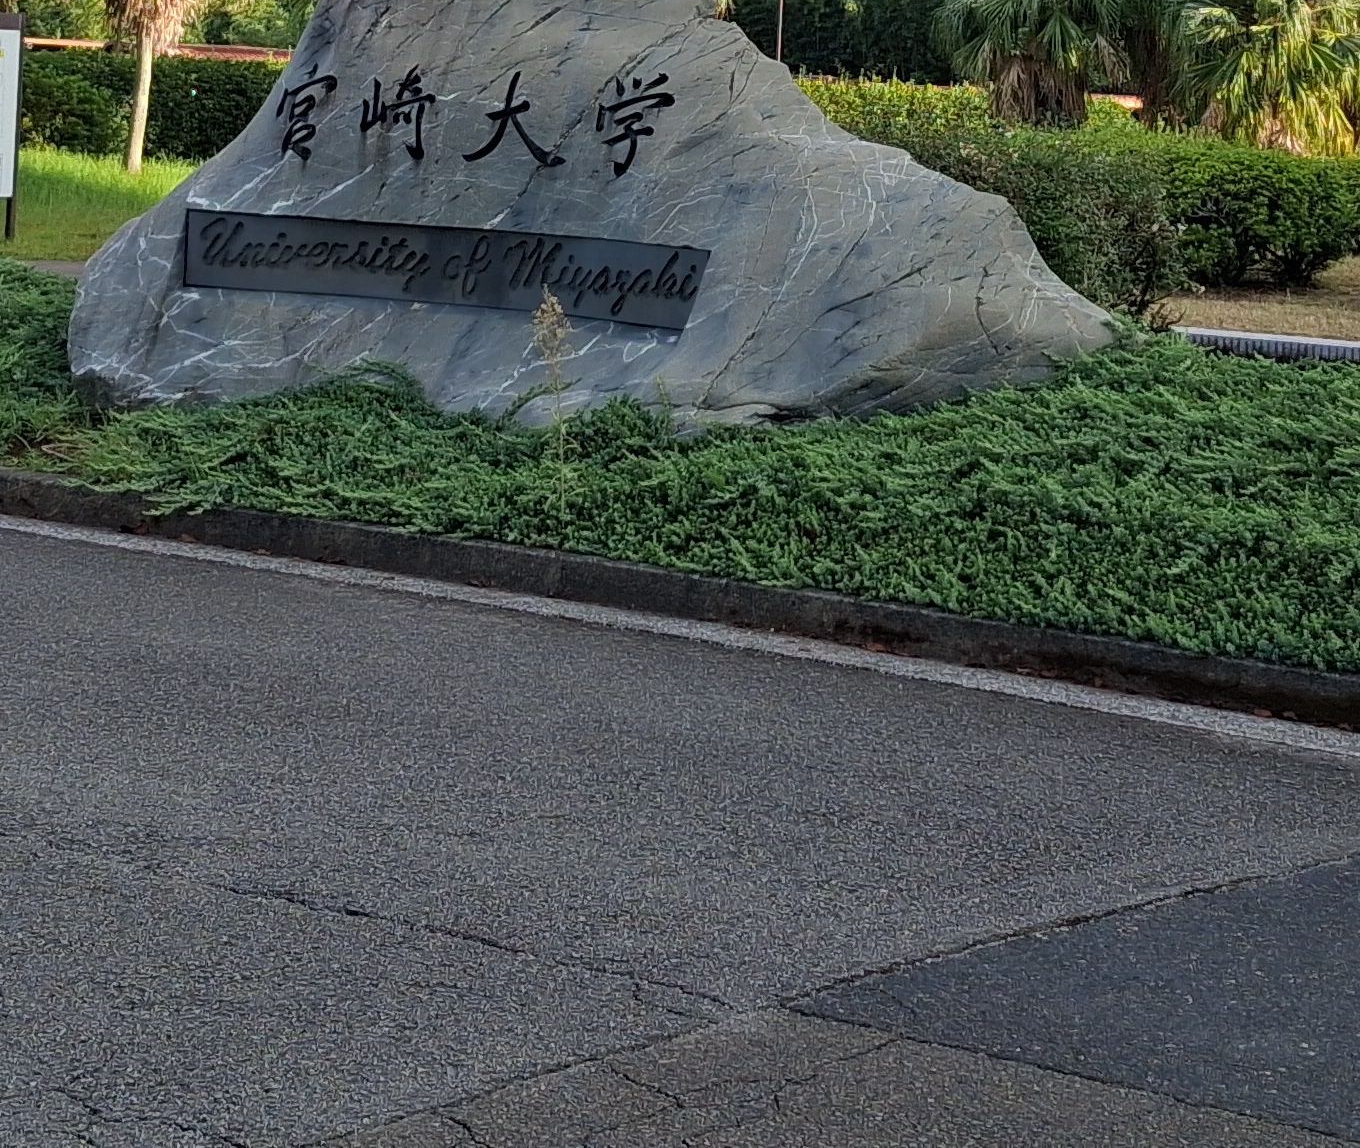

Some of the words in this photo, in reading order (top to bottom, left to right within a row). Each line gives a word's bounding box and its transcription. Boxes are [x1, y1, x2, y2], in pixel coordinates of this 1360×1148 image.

[276, 63, 676, 177] 宮崎大学
[200, 216, 431, 294] University
[443, 234, 493, 300] of
[502, 237, 699, 317] Miyazaki
